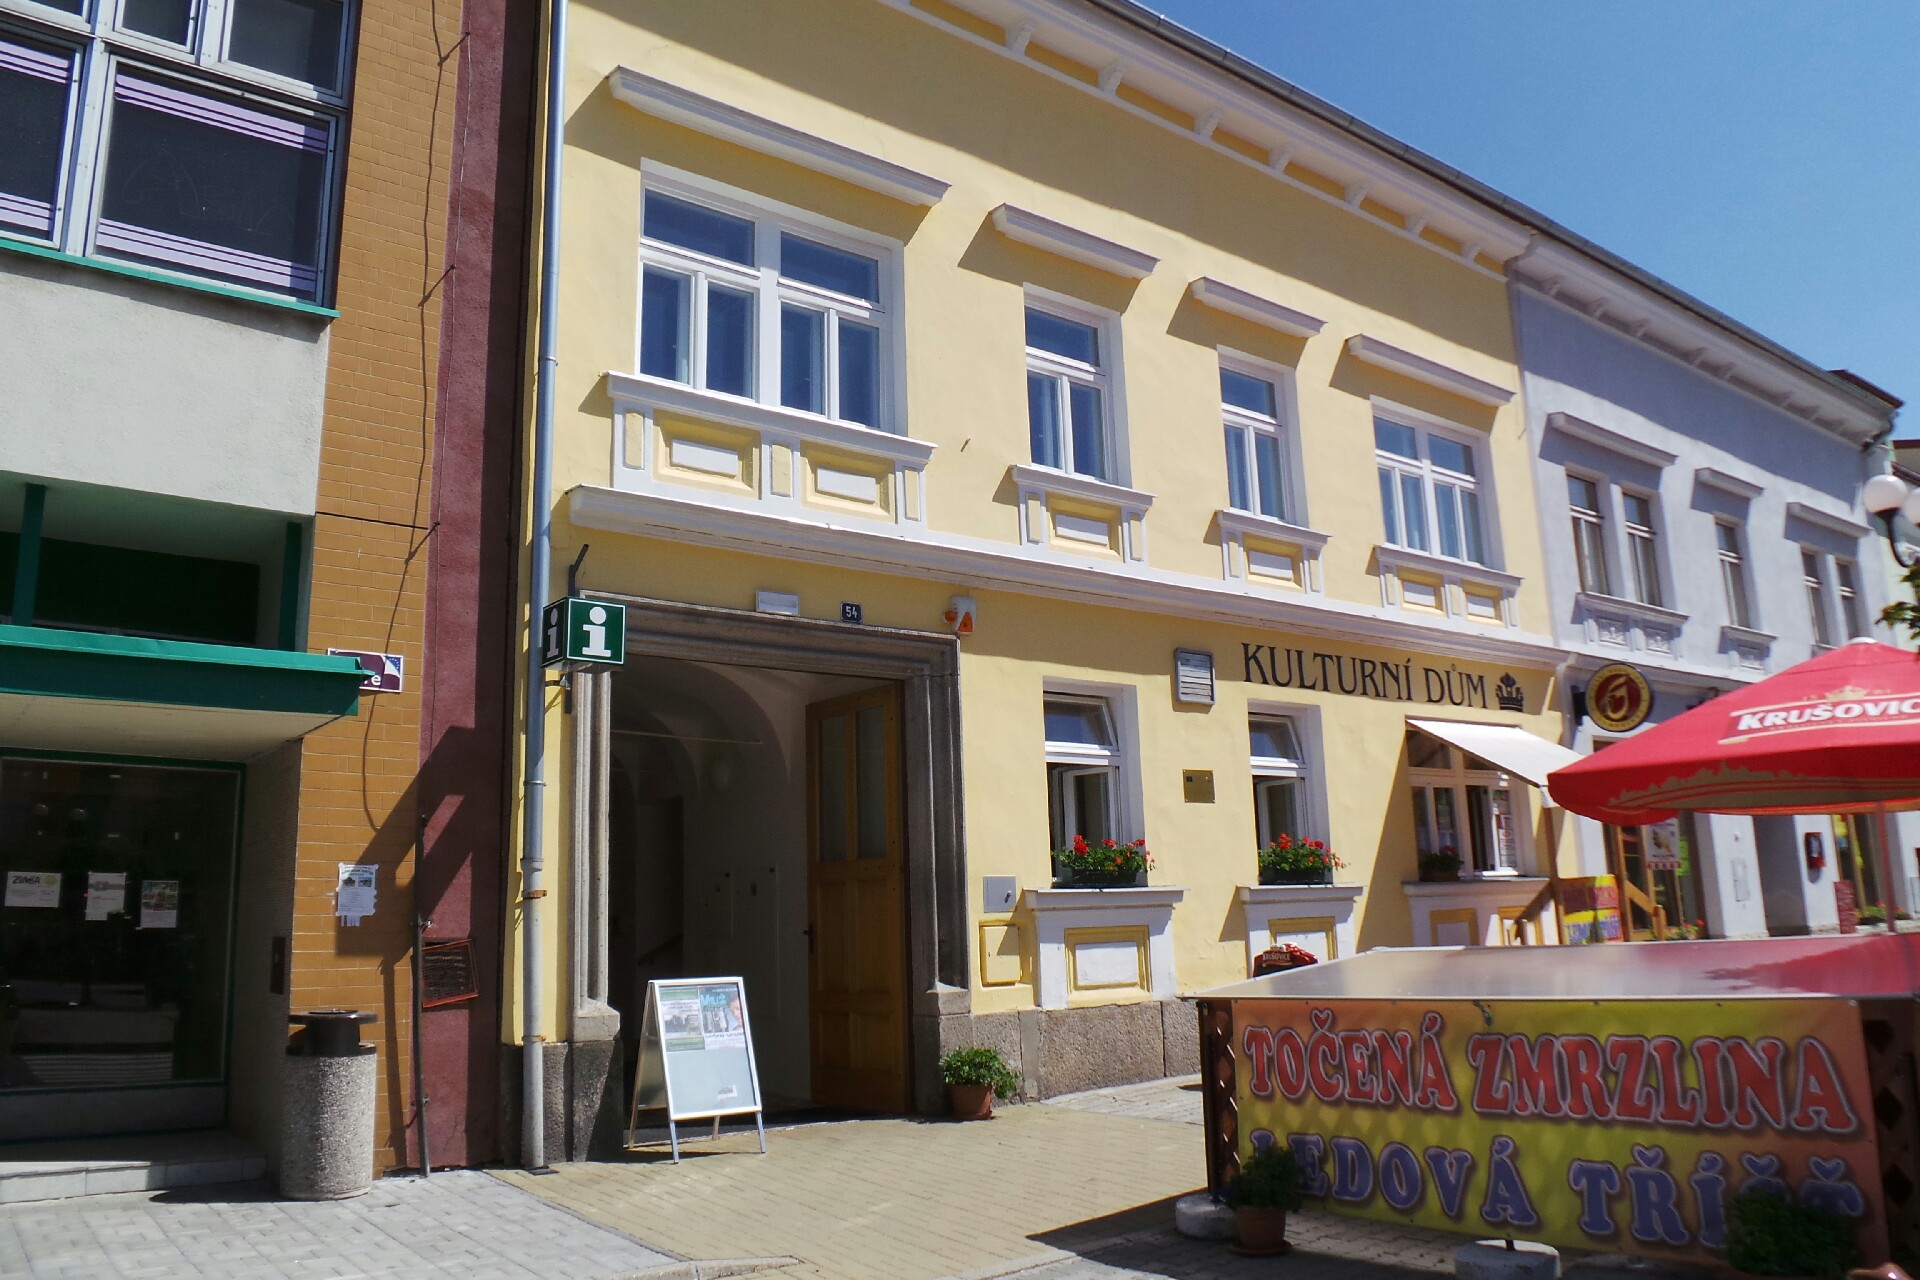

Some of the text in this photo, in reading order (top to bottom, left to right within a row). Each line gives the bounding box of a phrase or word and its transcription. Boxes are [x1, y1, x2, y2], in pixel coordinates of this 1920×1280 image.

[845, 605, 858, 619] 54
[1241, 642, 1414, 701] KULTURNÍ
[1422, 663, 1488, 709] DŮM
[1243, 1007, 1858, 1133] TOČENÁ ZMRZLINA
[1250, 1129, 1538, 1225] EDOVÁ
